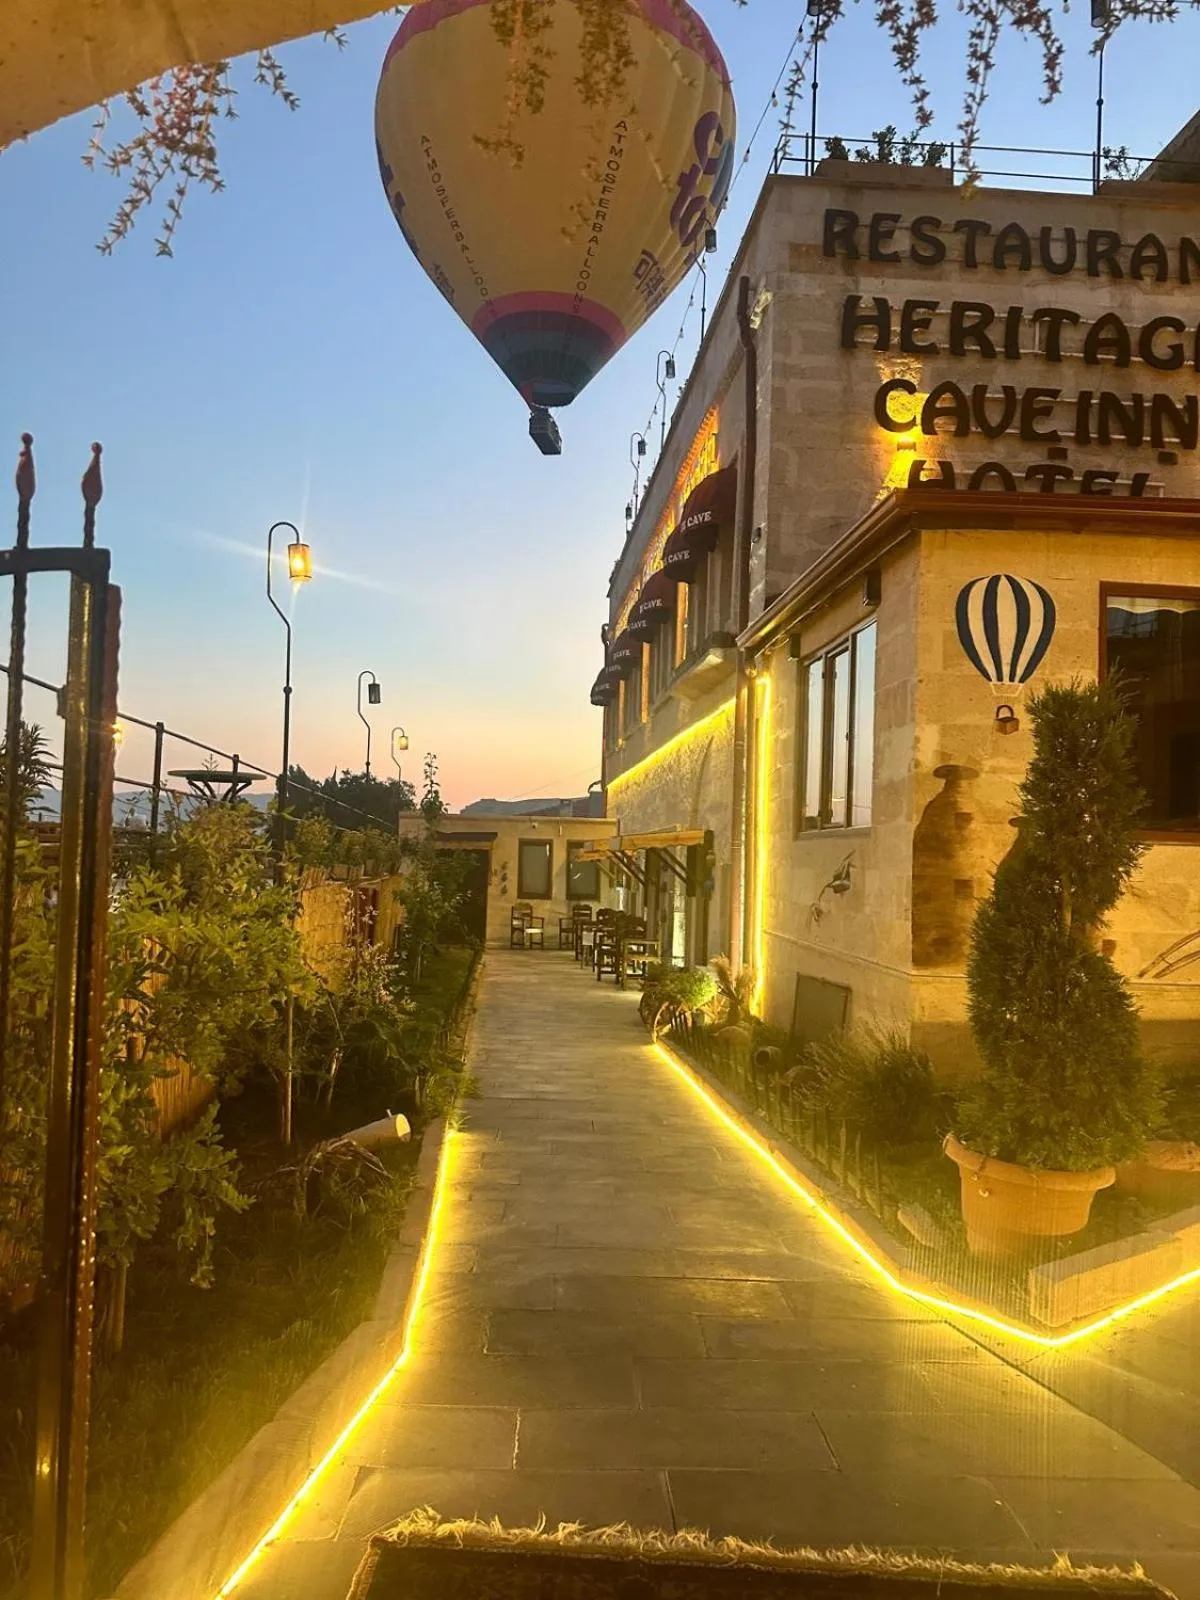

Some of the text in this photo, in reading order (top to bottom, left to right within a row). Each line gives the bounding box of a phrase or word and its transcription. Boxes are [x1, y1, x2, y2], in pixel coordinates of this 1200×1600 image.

[841, 295, 1200, 372] HERITAG
[874, 378, 1199, 450] CAVE INN
[687, 511, 712, 527] CAVE
[668, 550, 690, 563] CAVE
